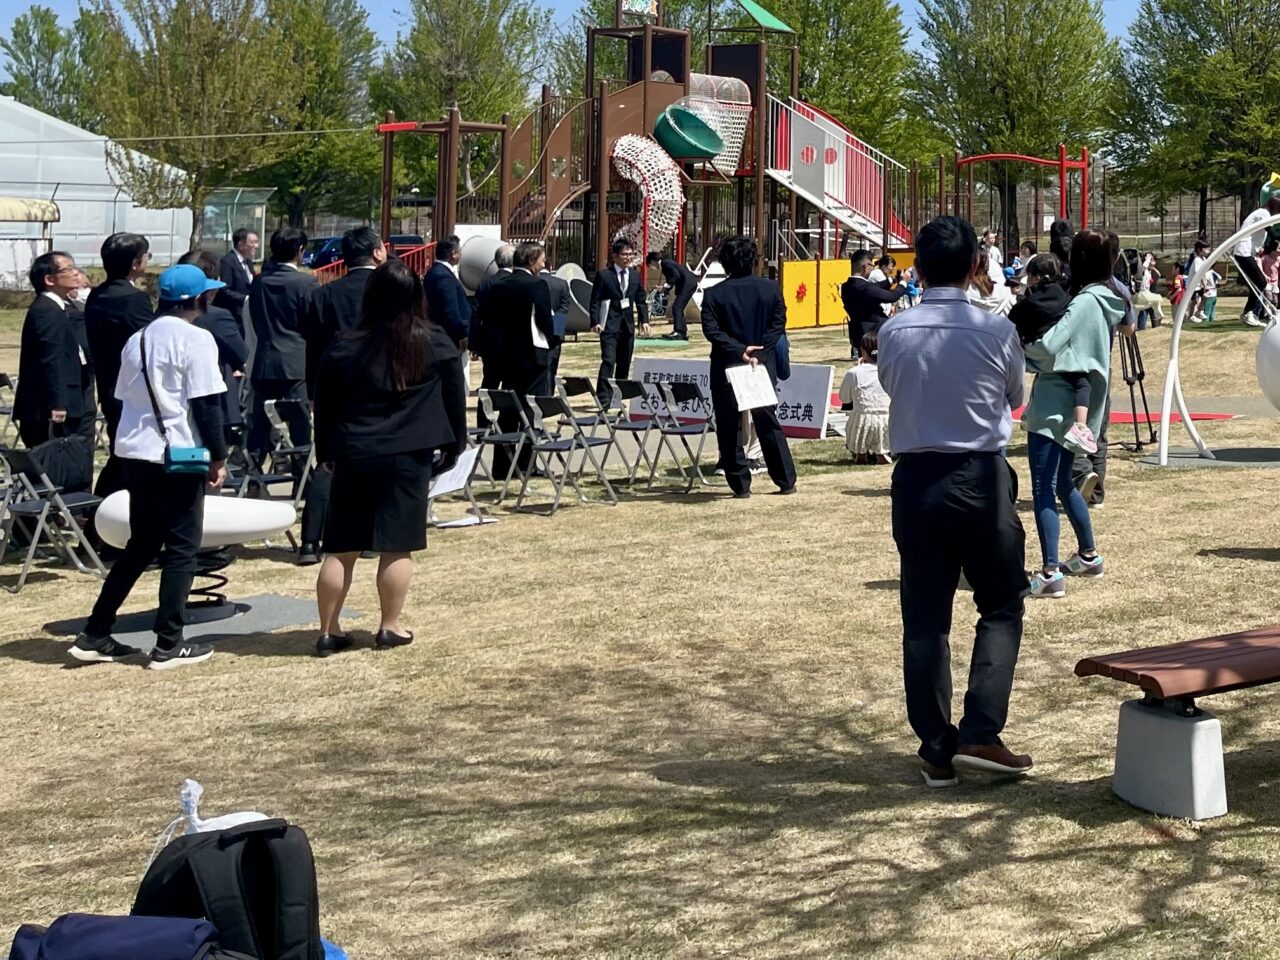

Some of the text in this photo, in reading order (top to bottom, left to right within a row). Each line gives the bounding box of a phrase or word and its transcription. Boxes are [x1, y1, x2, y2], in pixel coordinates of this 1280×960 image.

[776, 401, 813, 422] 念式典
[179, 648, 191, 656] N
